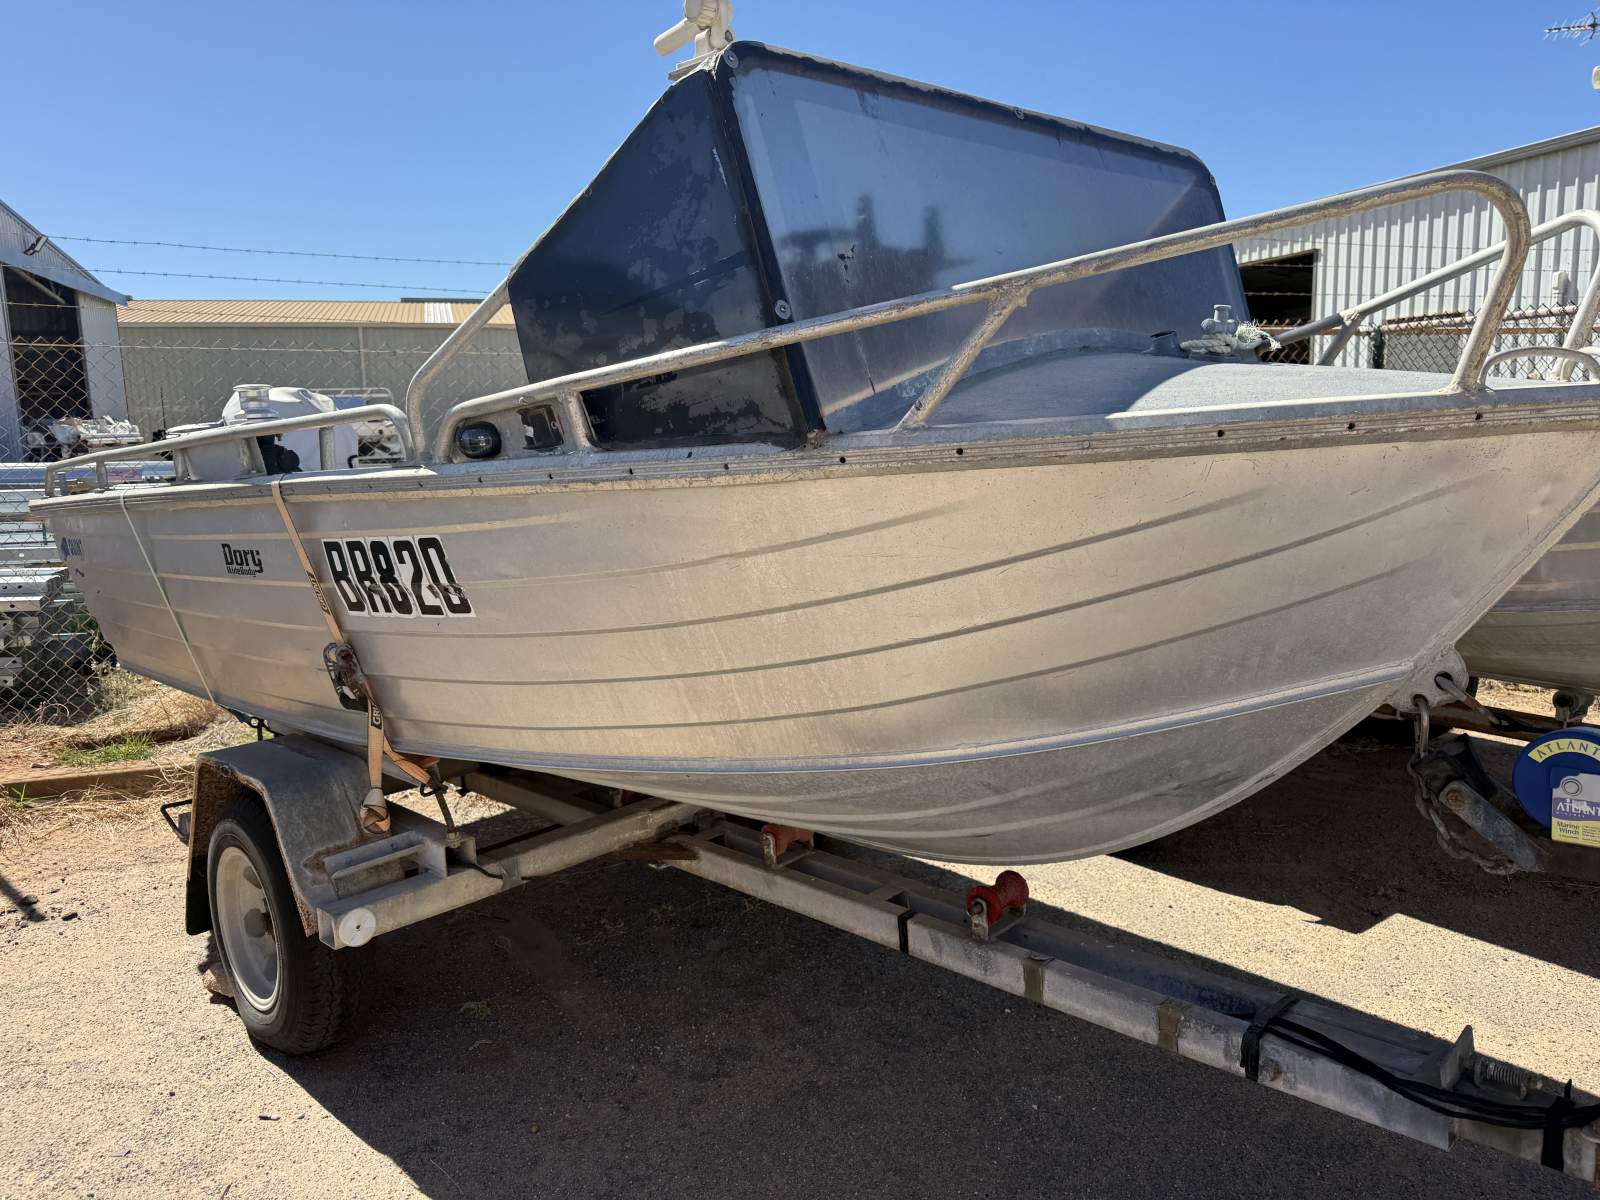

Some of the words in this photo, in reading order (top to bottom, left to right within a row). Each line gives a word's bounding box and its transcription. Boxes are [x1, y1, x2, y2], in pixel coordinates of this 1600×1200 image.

[221, 543, 263, 573] Dory
[323, 537, 472, 615] BR820
[1559, 827, 1580, 835] Winch
